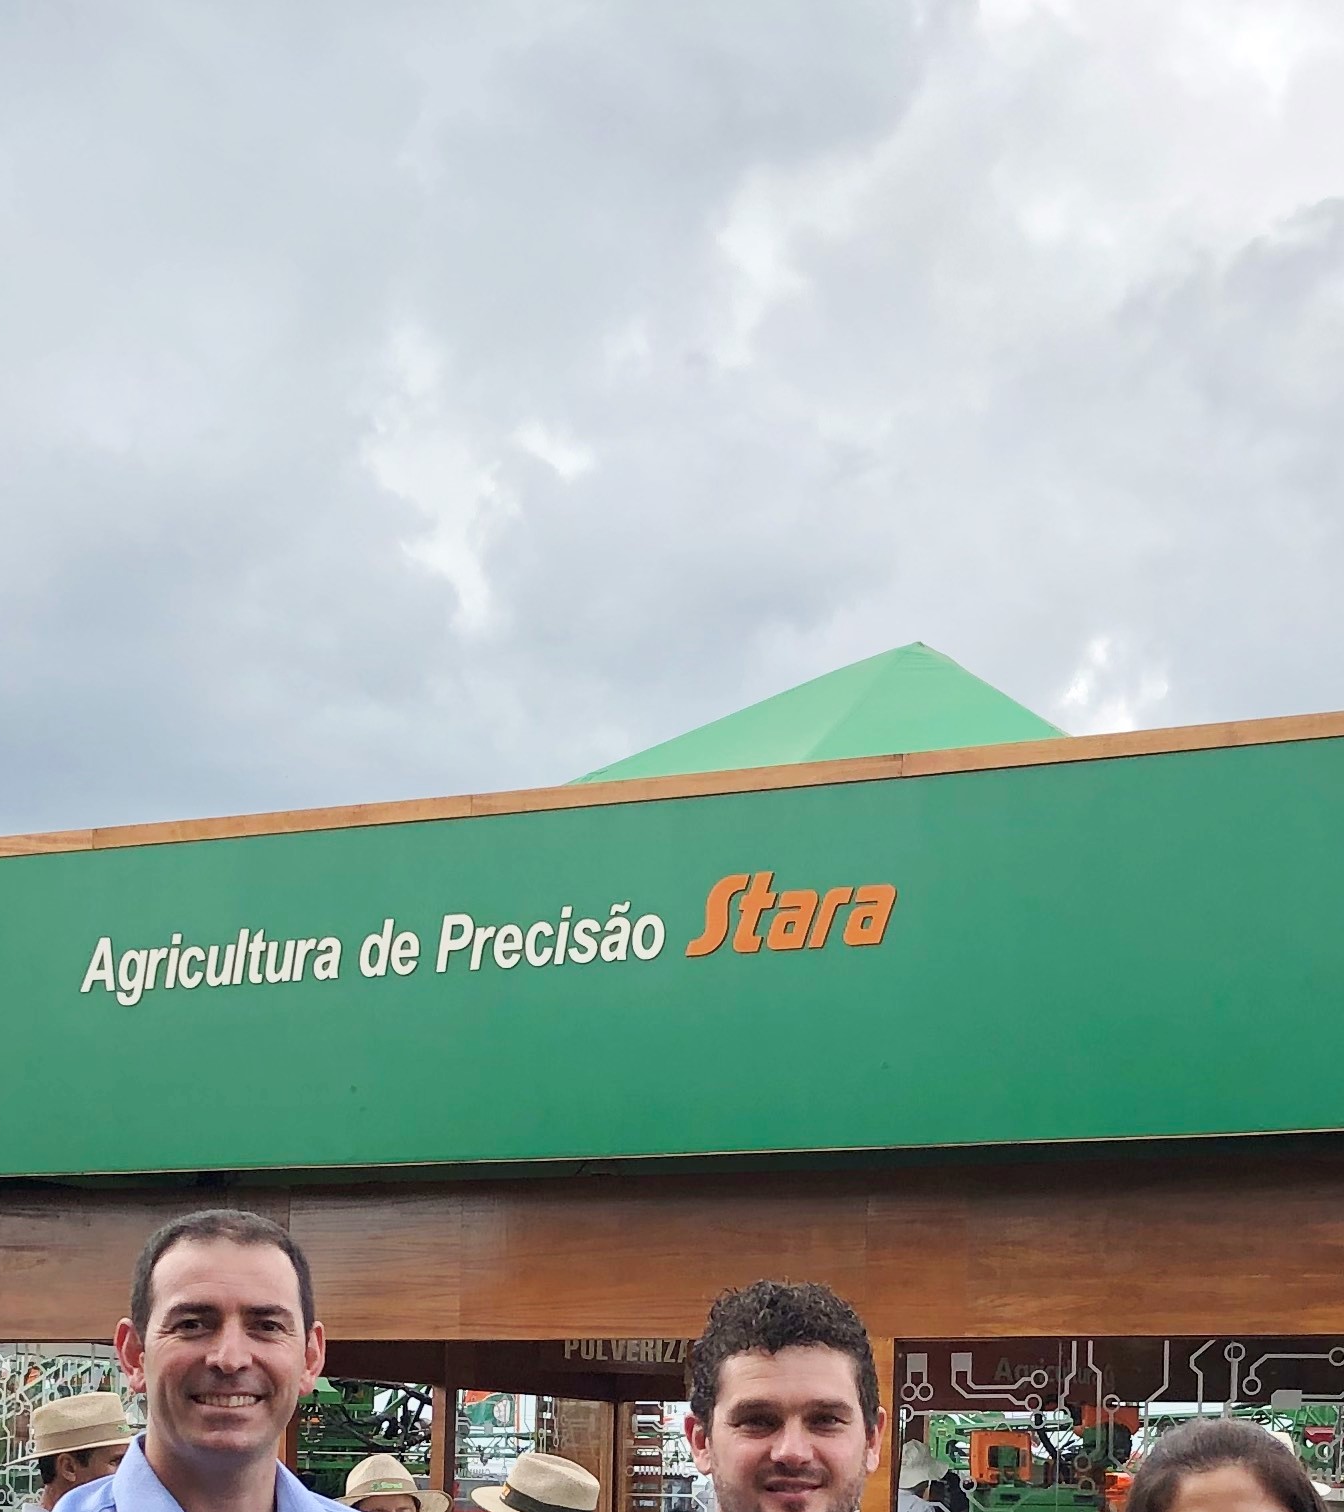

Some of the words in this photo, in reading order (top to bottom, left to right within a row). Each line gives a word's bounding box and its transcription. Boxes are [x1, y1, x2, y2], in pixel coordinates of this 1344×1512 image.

[80, 928, 342, 1006] Agricultura
[359, 918, 421, 978] de
[435, 901, 666, 973] Precisão
[685, 871, 897, 957] Stara
